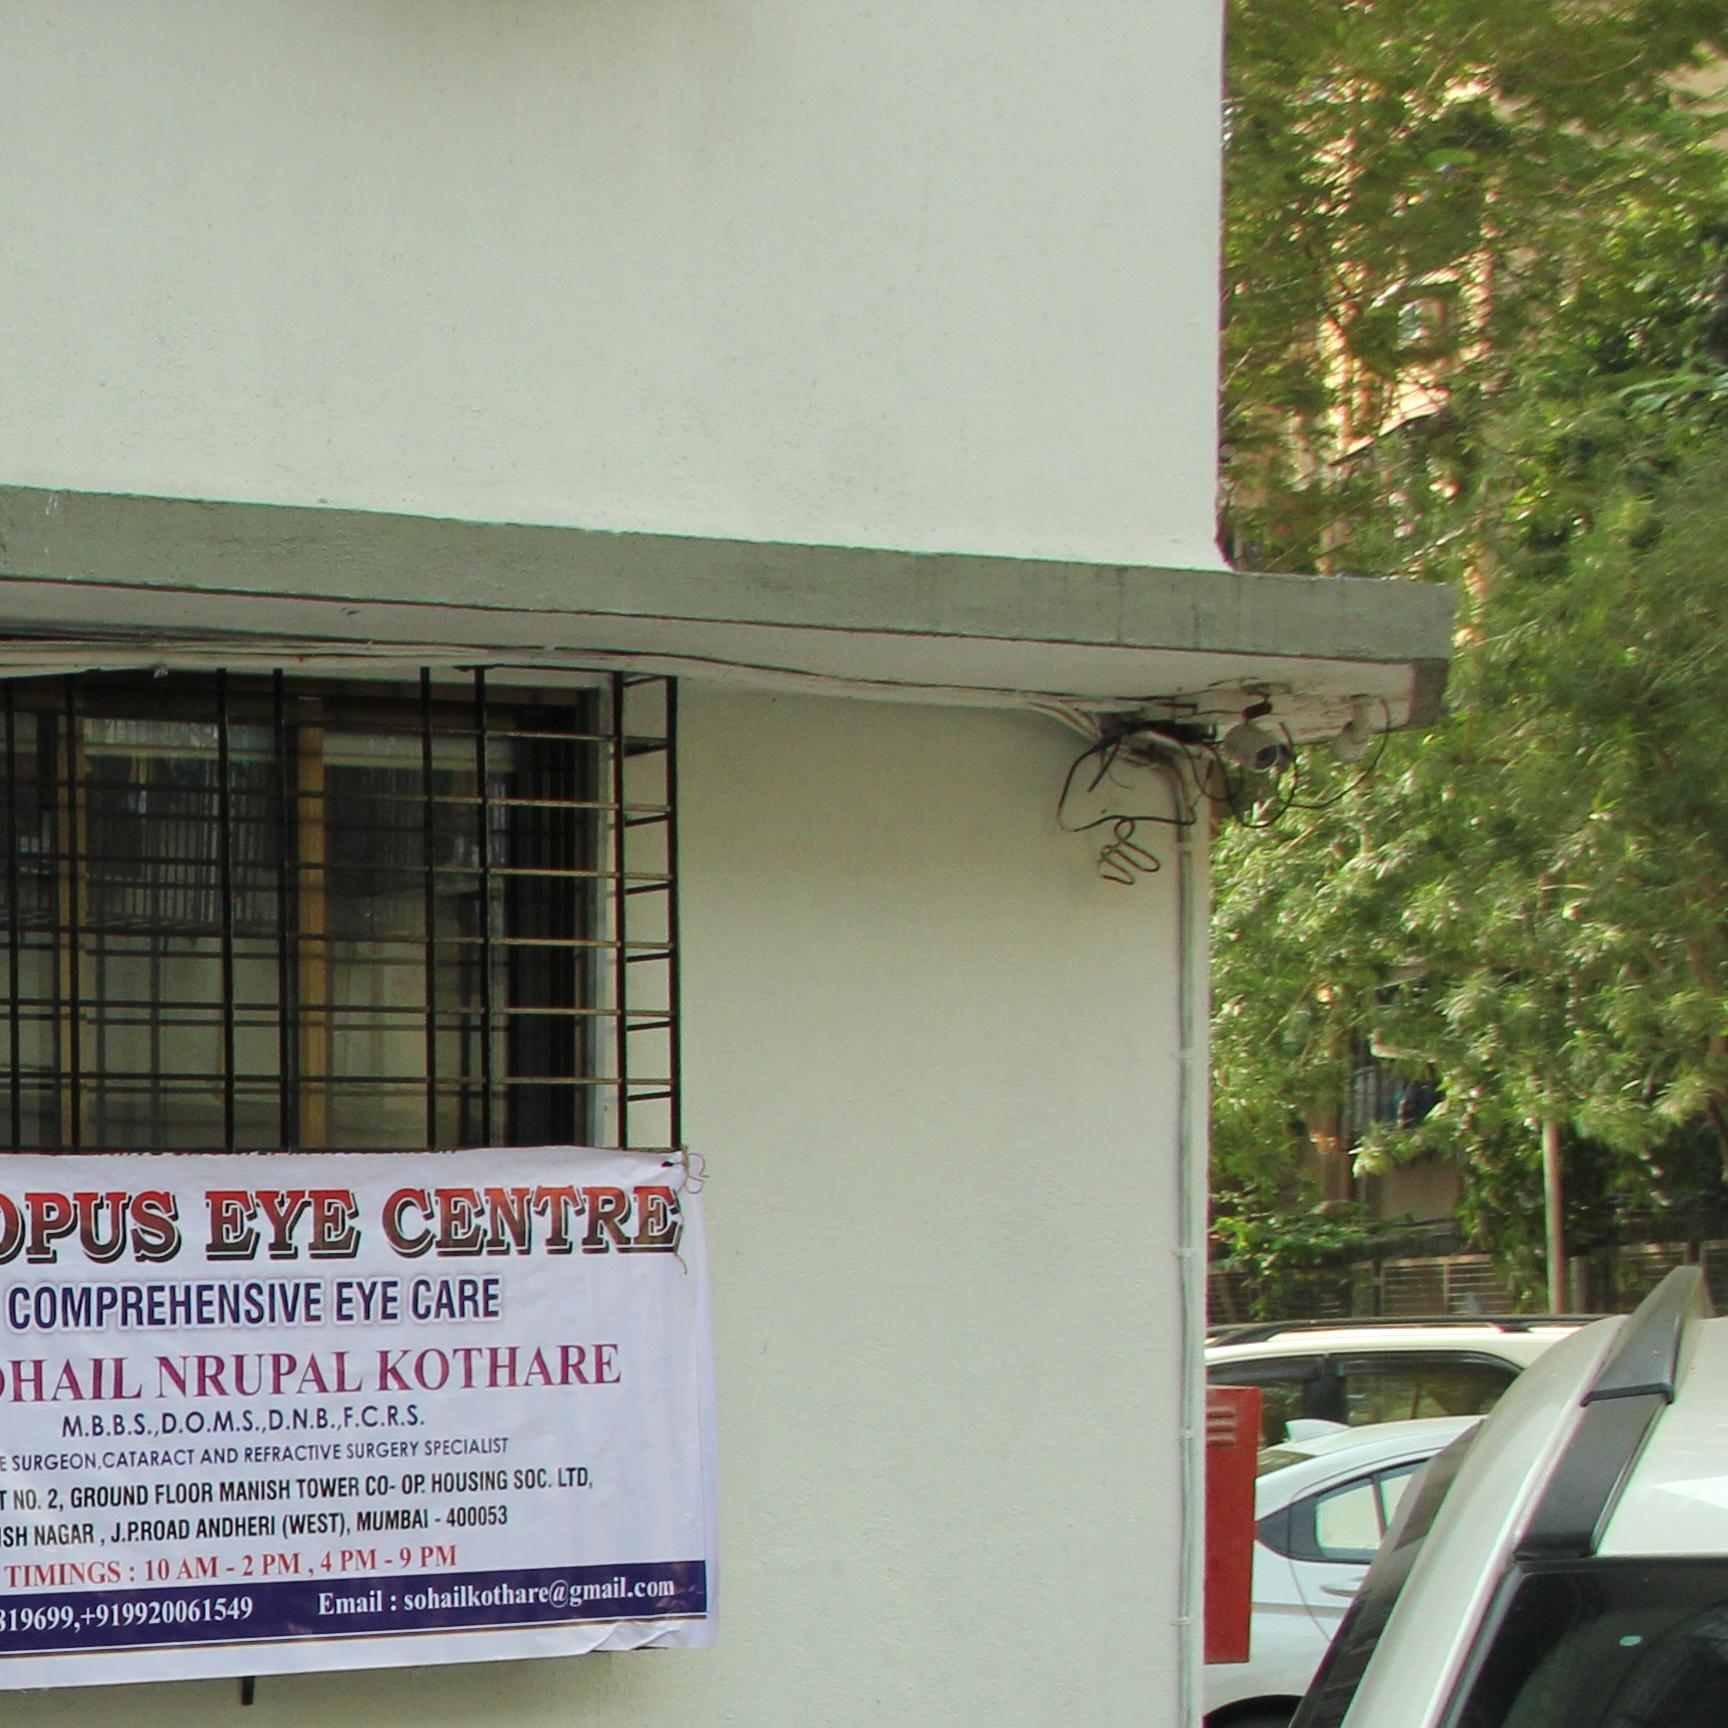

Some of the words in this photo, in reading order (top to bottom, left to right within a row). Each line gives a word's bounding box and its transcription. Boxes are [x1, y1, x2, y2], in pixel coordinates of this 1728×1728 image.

[204, 1189, 362, 1261] EYE
[381, 1185, 684, 1259] CENTRE
[7, 1282, 322, 1330] COMPREHENSIVE
[336, 1280, 399, 1322] EYE
[411, 1277, 501, 1320] CARE
[155, 1350, 363, 1400] NRUPAL
[375, 1344, 621, 1393] KOTHARE
[199, 1448, 239, 1465] AND
[243, 1443, 342, 1463] REFRACTIVE
[346, 1440, 420, 1460] SURGERY
[424, 1437, 509, 1457] SPECIALIST
[12, 1489, 43, 1512] NO.
[46, 1488, 65, 1513] 2,
[70, 1485, 149, 1509] GROUND
[154, 1482, 214, 1506] FLOOR
[218, 1479, 291, 1503] MANISH
[296, 1476, 360, 1499] TOWER
[365, 1474, 396, 1497] CO-
[431, 1469, 509, 1494] HOUSING
[513, 1468, 552, 1491] SOC.
[34, 1523, 95, 1547] NAGAR
[196, 1515, 276, 1539] ANDHERI
[281, 1512, 352, 1540] (WEST),
[356, 1508, 429, 1533] MUMBAI
[446, 1505, 509, 1528] 400053
[3, 1560, 121, 1588] TIMINGS
[144, 1558, 171, 1582] 10
[175, 1556, 219, 1580] AM
[241, 1554, 254, 1577] 2
[261, 1552, 301, 1576] PM
[320, 1550, 333, 1572] 4
[339, 1548, 378, 1572] PM
[399, 1547, 411, 1569] 9
[419, 1545, 458, 1568] PM
[317, 1589, 383, 1616] Email
[403, 1575, 675, 1611] sohailkothare@gmail.com
